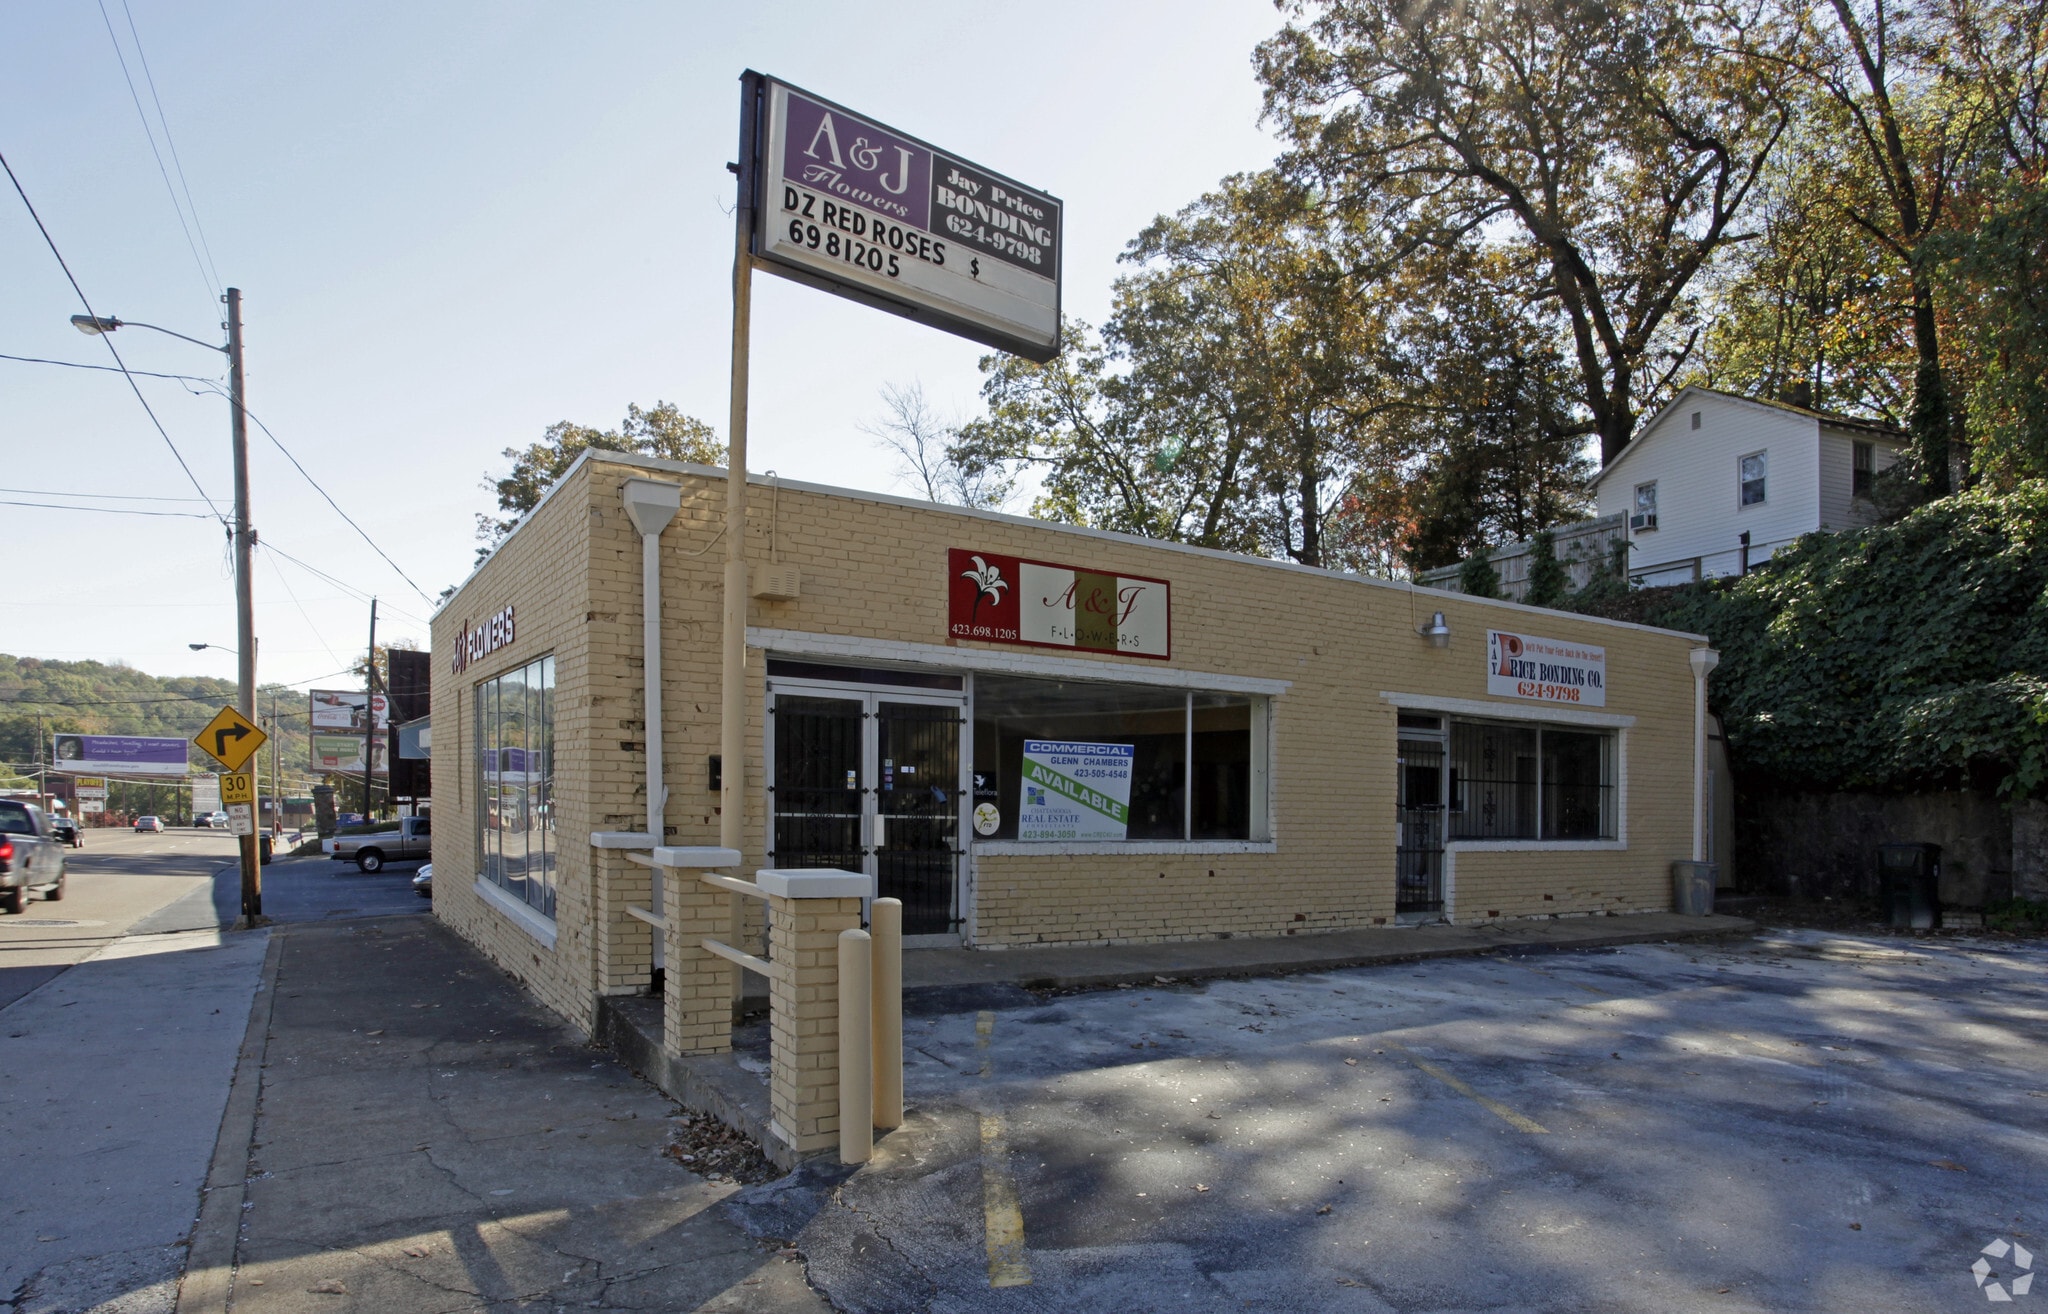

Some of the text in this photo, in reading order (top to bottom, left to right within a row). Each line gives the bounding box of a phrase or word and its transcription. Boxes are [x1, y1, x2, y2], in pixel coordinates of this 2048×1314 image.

[803, 164, 909, 218] Flowers
[947, 169, 1044, 221] Jay Price
[784, 186, 946, 265] DZ RED ROSES
[936, 185, 1052, 247] BONDING
[946, 214, 1042, 265] 624-9798
[969, 257, 981, 278] $
[468, 605, 516, 664] FLOWERS
[951, 623, 1018, 640] 423.698.1205
[1498, 634, 1603, 688] PRICE BONDING CO.
[1517, 681, 1580, 702] 624-9798
[1029, 743, 1129, 756] COMMERCIAL
[1050, 756, 1129, 767] GLENN CHAMBERS
[225, 776, 246, 792] 30
[1074, 768, 1128, 779] 423-505-4548
[1031, 765, 1122, 819] AVAILABLE
[1021, 814, 1081, 824] REAL ESTATE
